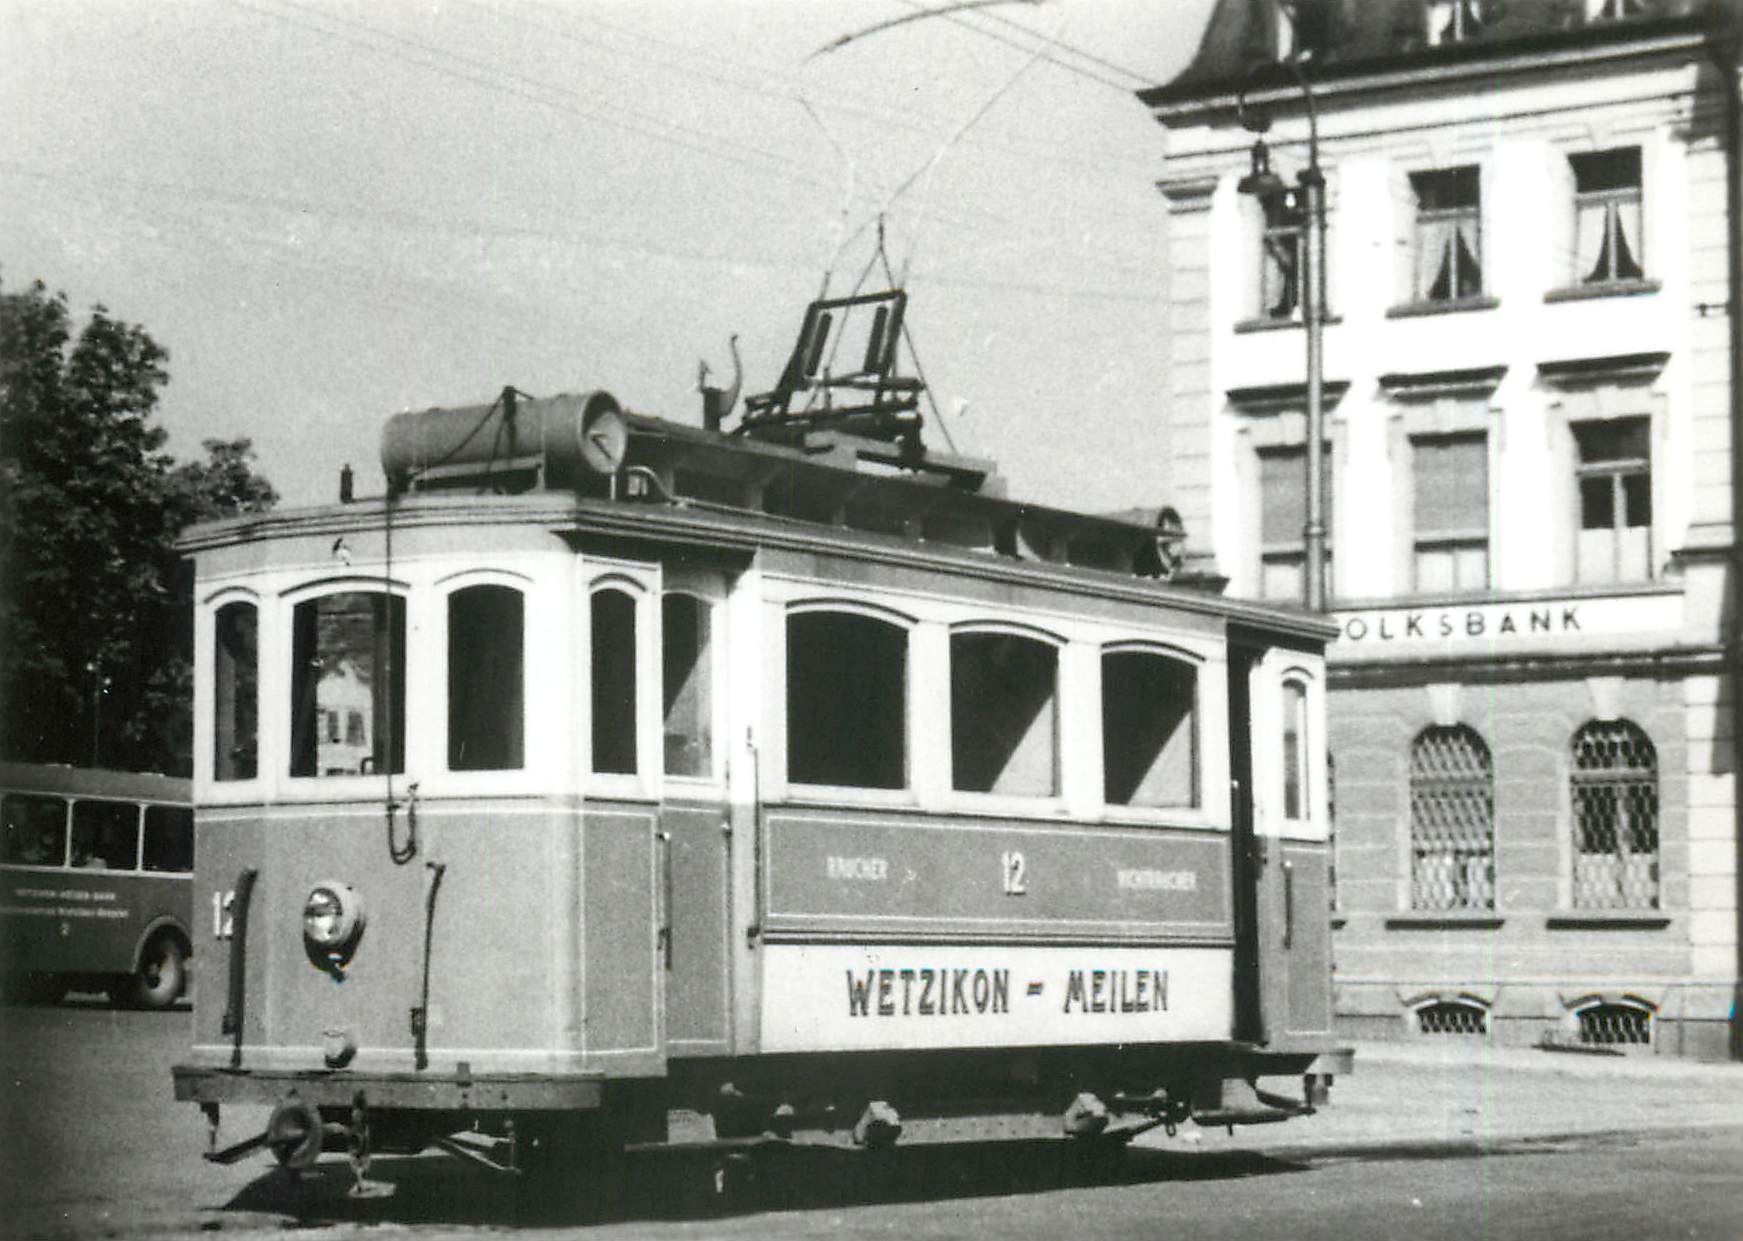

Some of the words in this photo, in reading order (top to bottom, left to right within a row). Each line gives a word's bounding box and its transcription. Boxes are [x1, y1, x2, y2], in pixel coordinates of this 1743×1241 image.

[1345, 609, 1582, 640] OLKSBANK
[1001, 851, 1025, 892] 12
[846, 969, 1010, 1016] WETZIKON
[1027, 982, 1043, 996] -
[1063, 969, 1169, 1014] MEILEN
